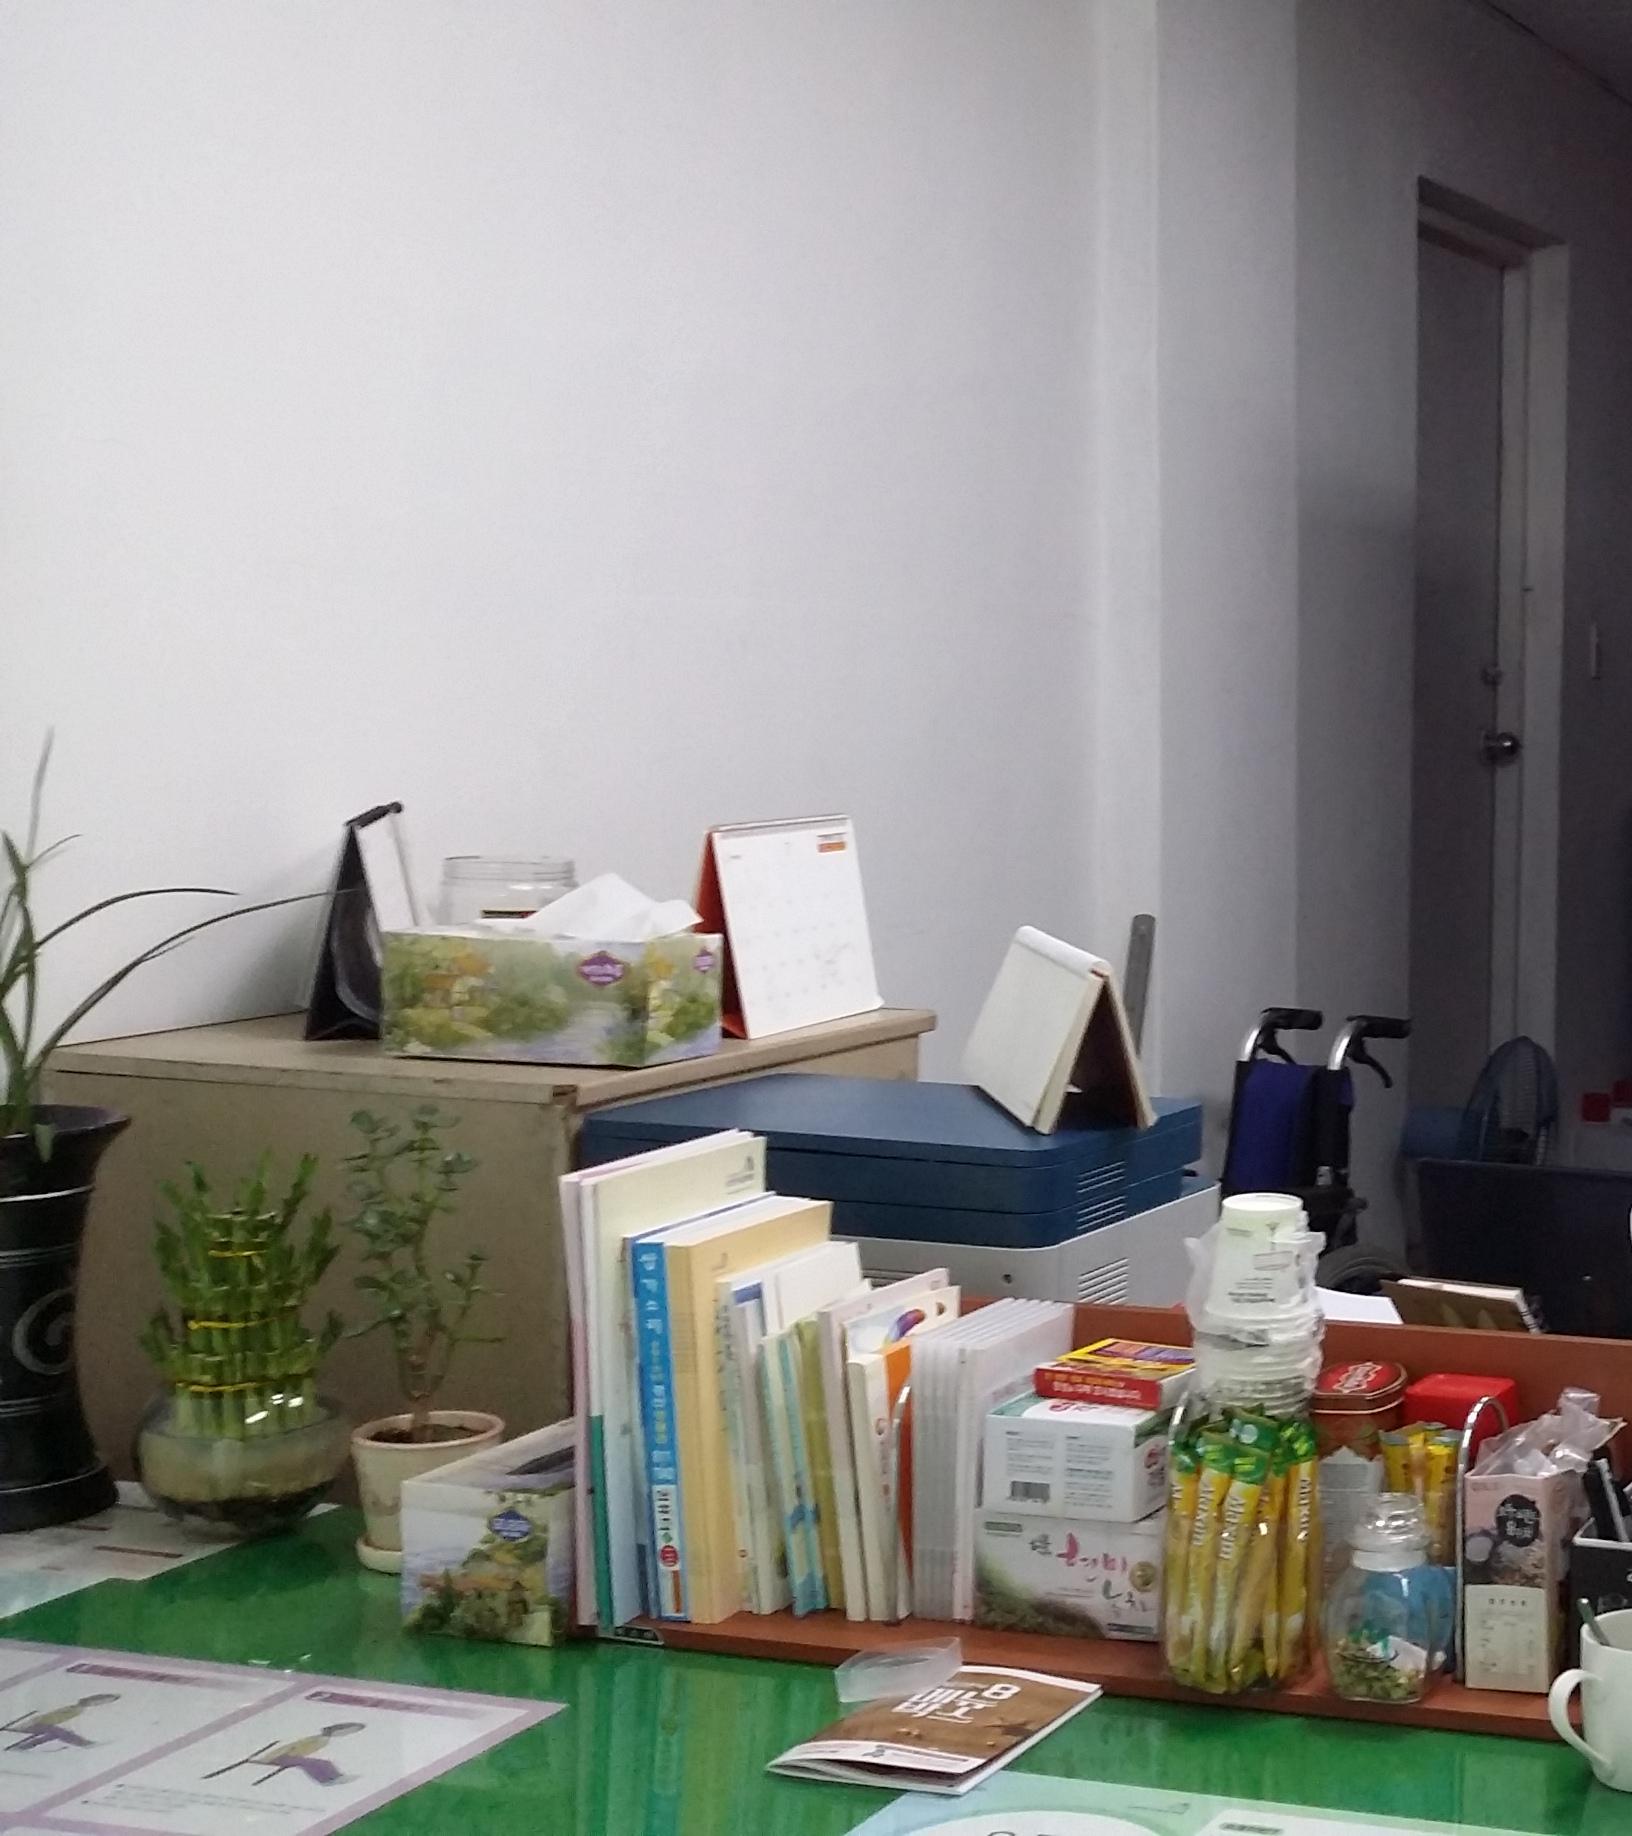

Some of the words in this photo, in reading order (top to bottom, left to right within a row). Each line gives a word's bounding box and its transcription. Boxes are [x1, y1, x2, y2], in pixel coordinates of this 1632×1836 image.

[1191, 1486, 1216, 1547] Maxim
[1218, 1495, 1246, 1561] Maxim
[982, 1683, 1021, 1700] 8
